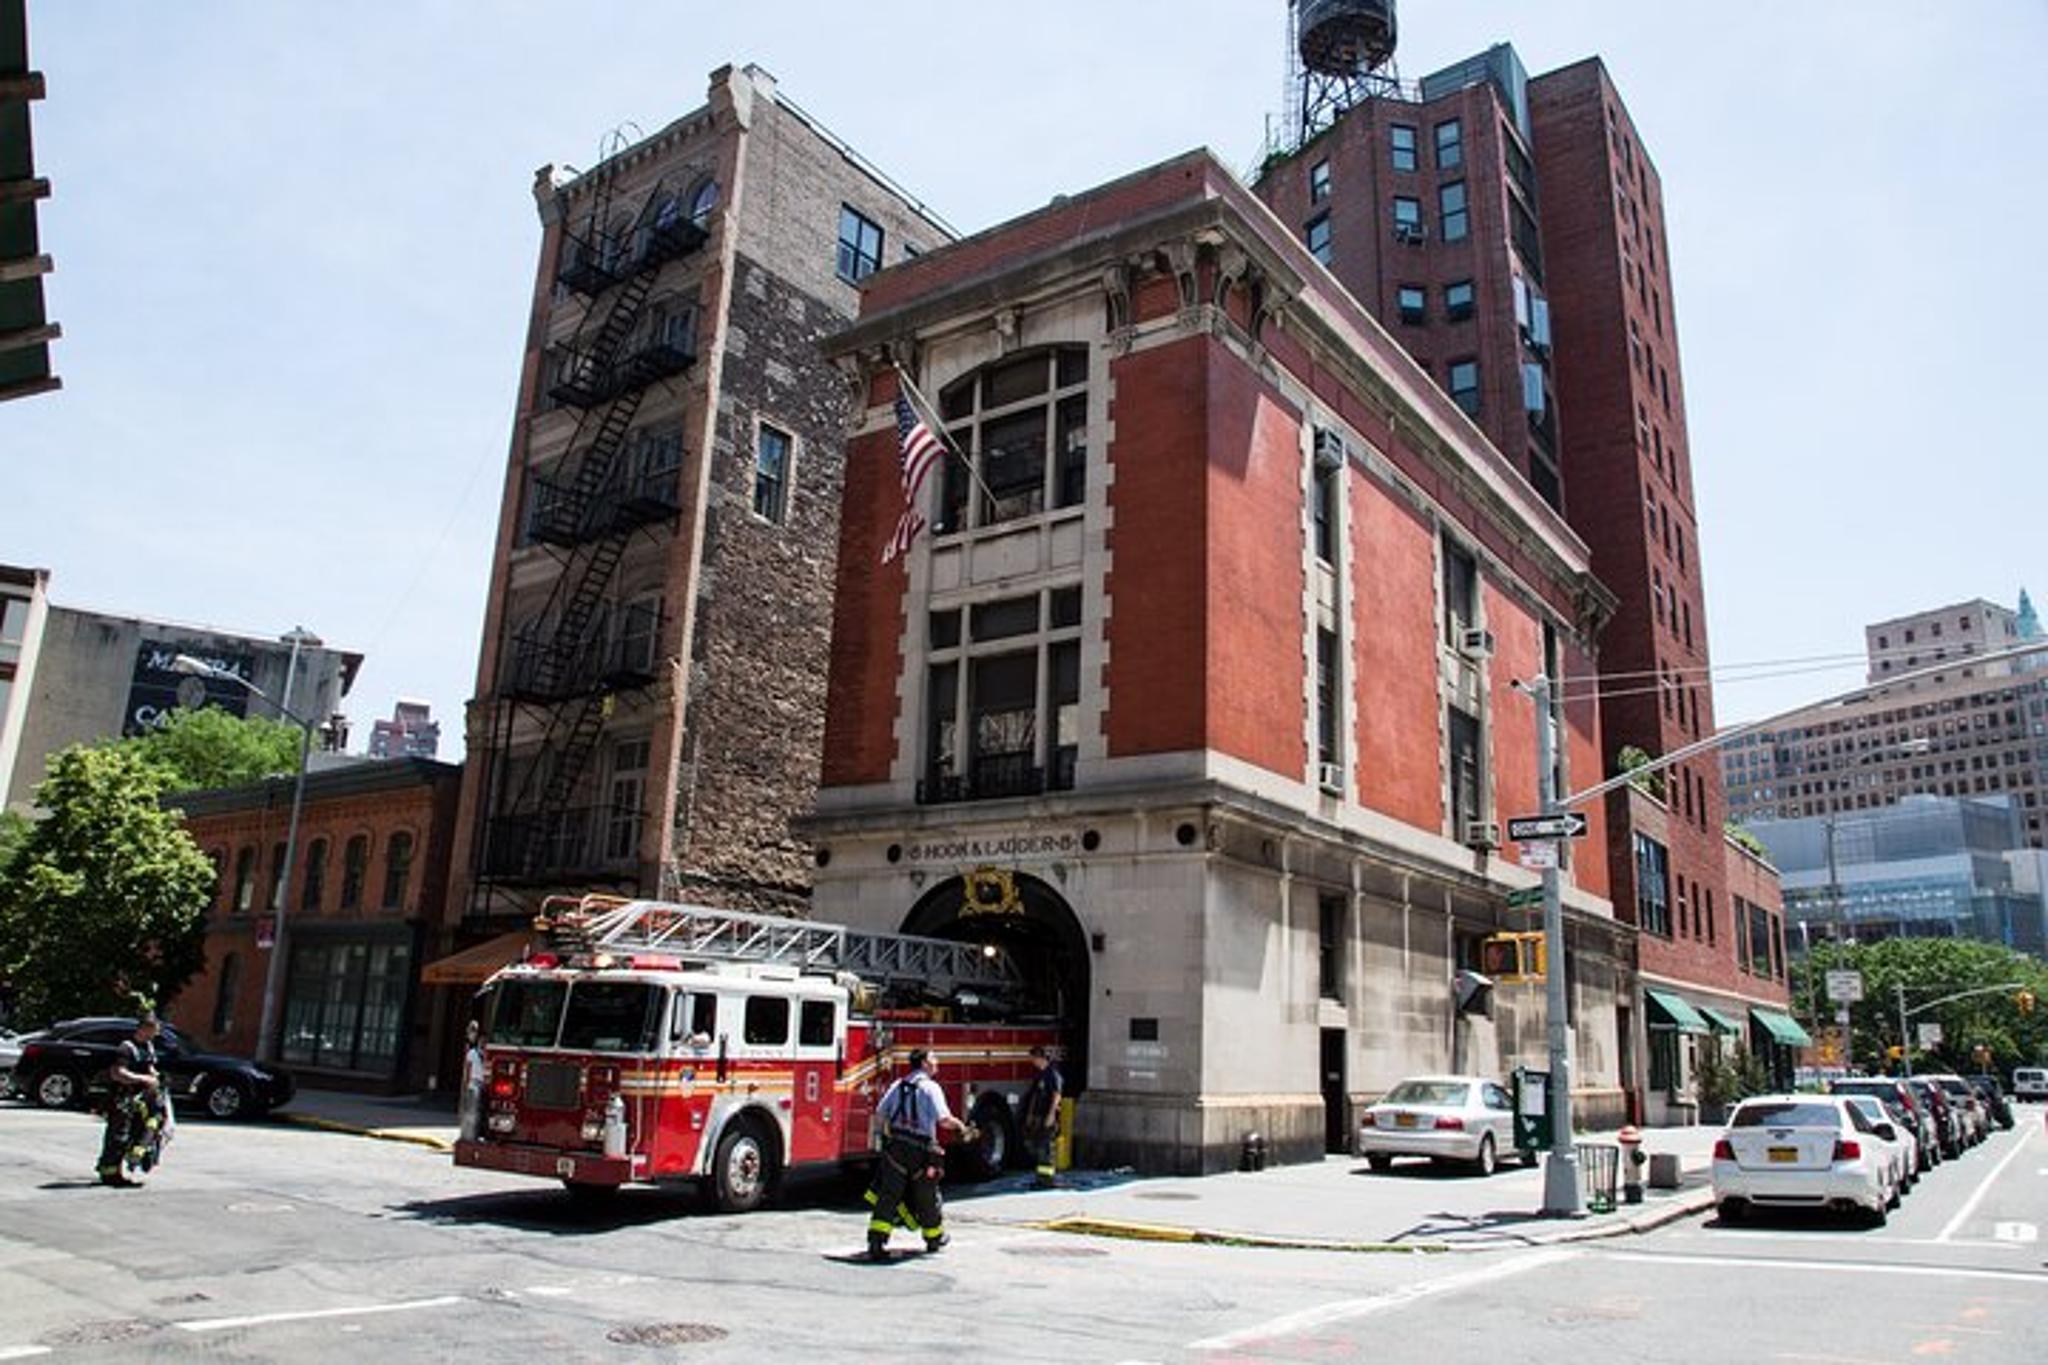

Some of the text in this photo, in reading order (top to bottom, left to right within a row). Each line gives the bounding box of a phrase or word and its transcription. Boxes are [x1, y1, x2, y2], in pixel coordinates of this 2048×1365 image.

[924, 842, 968, 859] HOOK
[971, 841, 982, 857] &
[985, 836, 1053, 856] LADDER
[806, 1071, 819, 1102] 8
